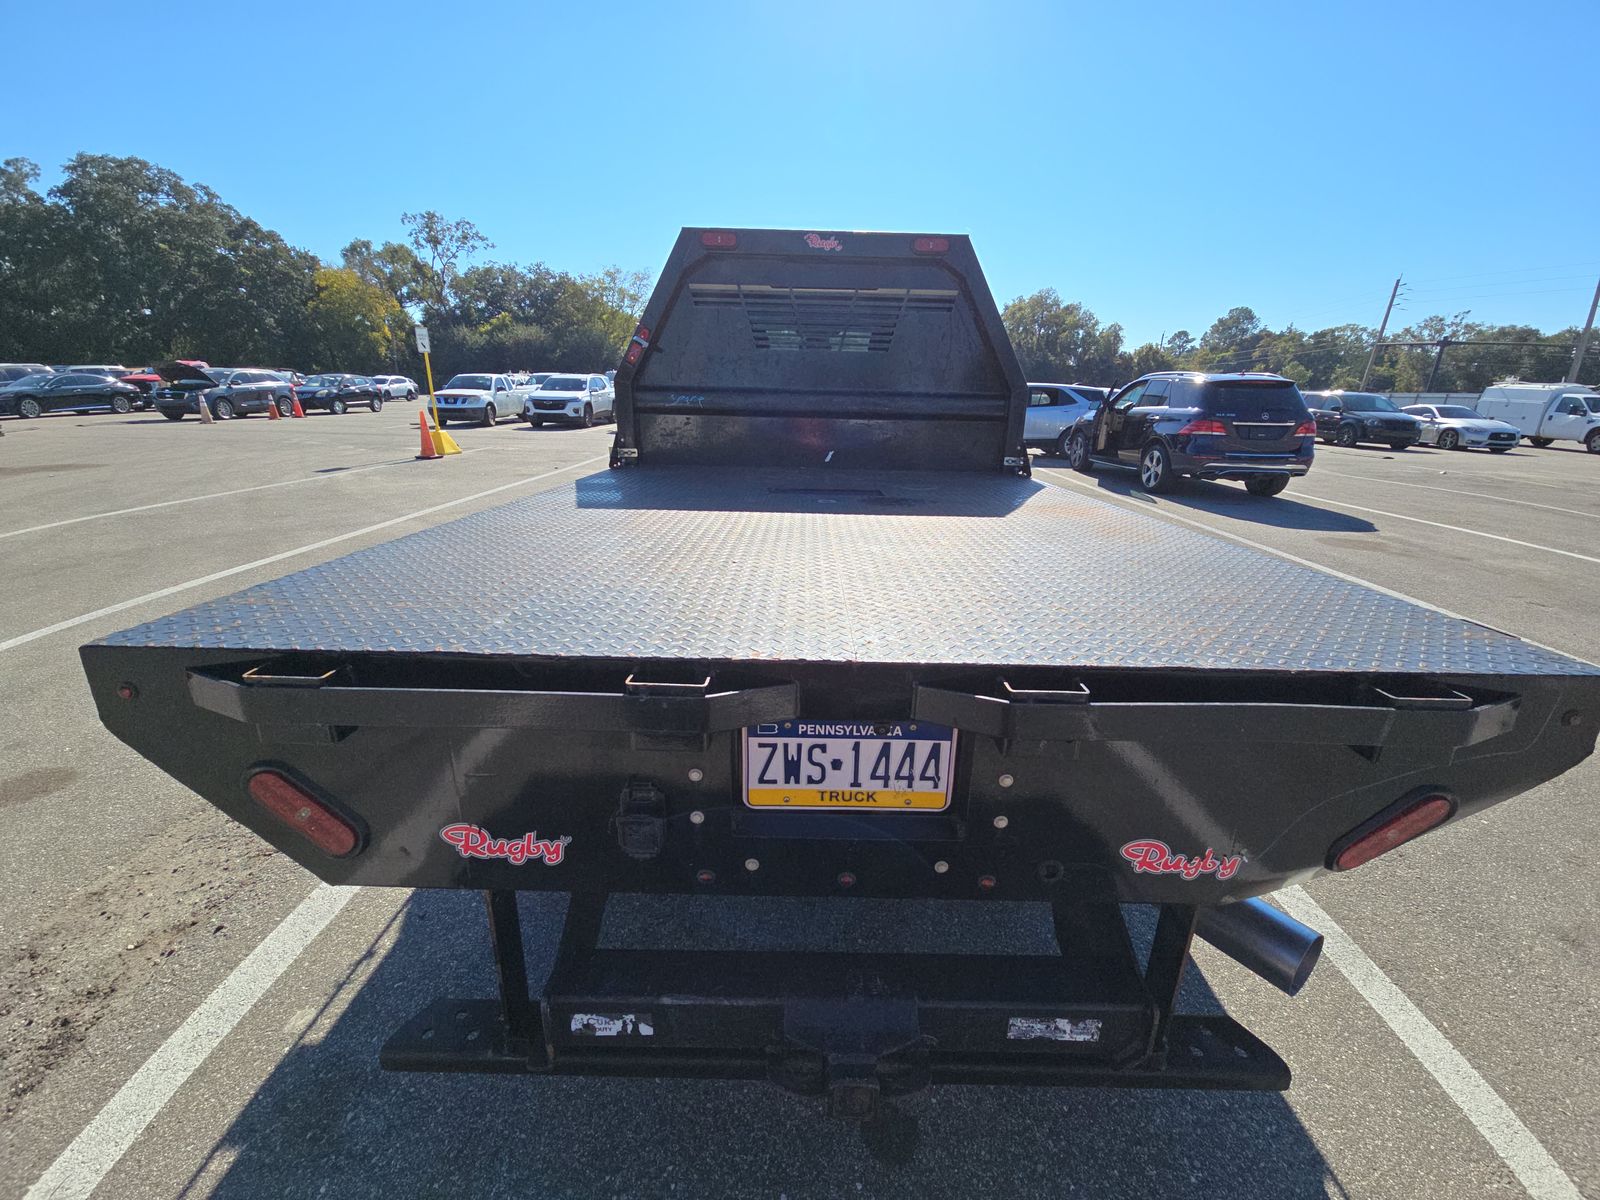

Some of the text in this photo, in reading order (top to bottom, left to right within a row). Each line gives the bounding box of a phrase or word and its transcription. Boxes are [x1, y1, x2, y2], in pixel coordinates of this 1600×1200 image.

[798, 724, 902, 737] PENNSYLVAIA
[818, 790, 877, 803] TRUCK
[440, 823, 564, 866] Rugby
[1120, 839, 1242, 881] Rugby
